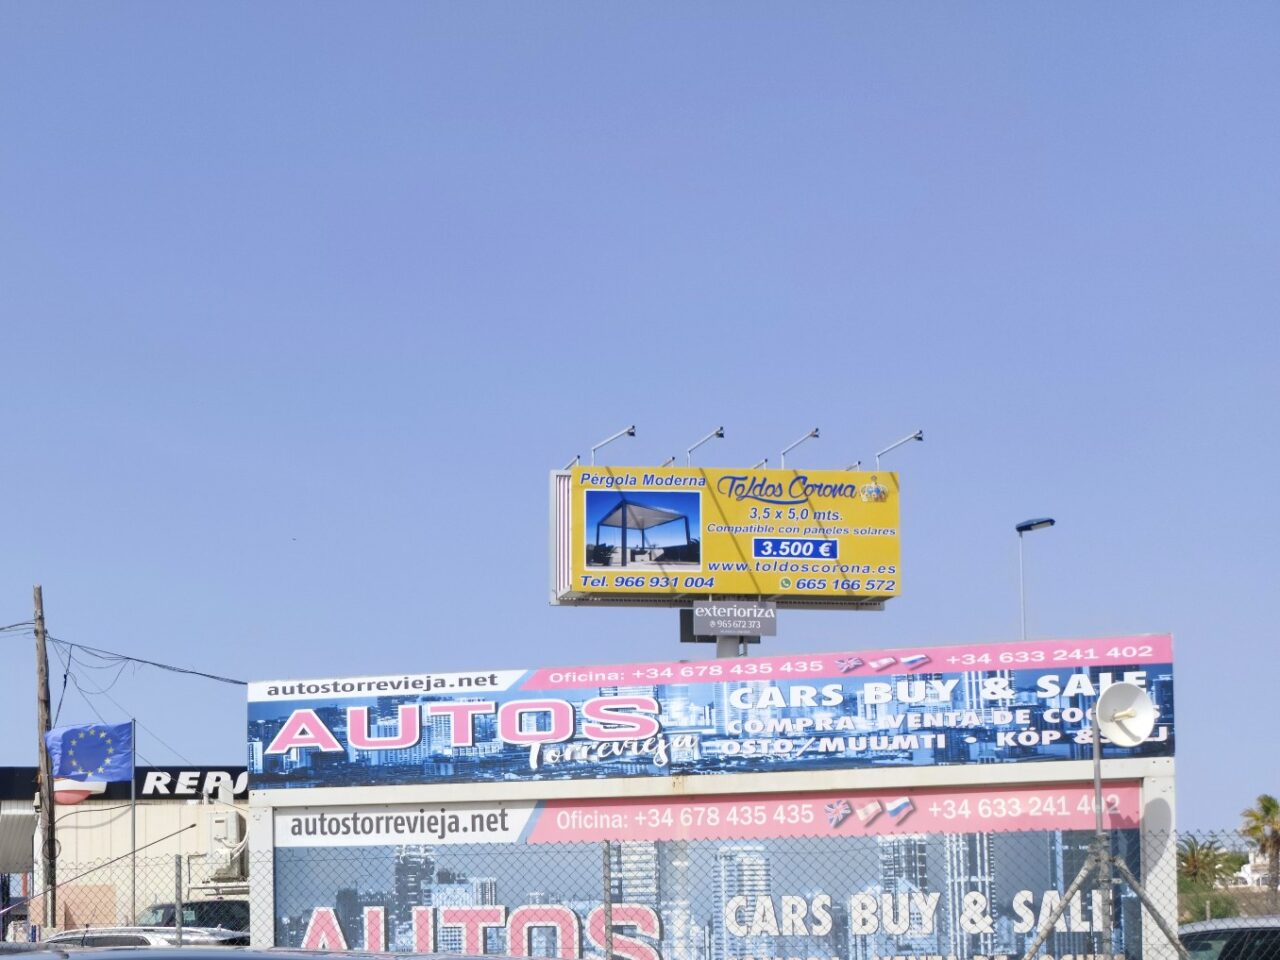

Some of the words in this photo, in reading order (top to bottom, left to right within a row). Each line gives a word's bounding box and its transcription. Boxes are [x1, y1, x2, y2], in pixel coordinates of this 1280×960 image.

[580, 473, 637, 487] Pérgola
[642, 474, 707, 486] Moderna
[717, 475, 788, 503] Toldos
[788, 475, 857, 499] Corona
[749, 507, 770, 521] 3,5
[775, 510, 783, 519] x
[788, 508, 809, 521] 5,0
[813, 509, 843, 521] mts.
[707, 523, 775, 535] Compatible
[778, 525, 800, 534] con
[803, 524, 849, 536] paneles
[853, 525, 896, 535] solares
[760, 541, 814, 556] 3.500
[818, 542, 833, 557] €
[708, 561, 896, 574] www.toldoscorona.es
[580, 575, 609, 587] Tel.
[614, 576, 645, 587] 966
[649, 576, 678, 588] 931
[684, 577, 714, 588] 004
[796, 578, 827, 590] 665
[833, 579, 860, 591] 166
[865, 579, 896, 591] 572
[695, 604, 775, 618] exterioriza
[716, 620, 732, 628] 965
[732, 620, 746, 628] 672
[747, 621, 761, 629] 373
[947, 653, 993, 665] +34
[1000, 650, 1050, 663] 633
[1053, 648, 1098, 661] 241
[1106, 645, 1153, 659] 402
[549, 670, 625, 684] Oficina:
[632, 668, 674, 680] +34
[680, 665, 724, 677] 678
[729, 663, 773, 675] 435
[780, 661, 824, 673] 435
[267, 673, 498, 696] autostorrevieja.net
[728, 684, 844, 709] CARS
[864, 679, 960, 704] BUY
[980, 677, 1017, 700] &
[264, 696, 663, 755] AUTOS
[727, 715, 855, 735] COMPRA
[883, 710, 981, 729] VENTA
[993, 709, 1030, 725] DE
[997, 727, 1061, 746] KÖP
[557, 809, 628, 830] Oficina:
[635, 807, 674, 829] +34
[680, 806, 720, 828] 678
[725, 805, 767, 826] 435
[773, 803, 814, 824] 435
[929, 800, 971, 819] +34
[978, 798, 1022, 818] 633
[1028, 796, 1071, 816] 241
[291, 808, 509, 840] autostorrevieja.net
[725, 894, 833, 937] CARS
[851, 892, 941, 935] BUY
[959, 890, 995, 934] &
